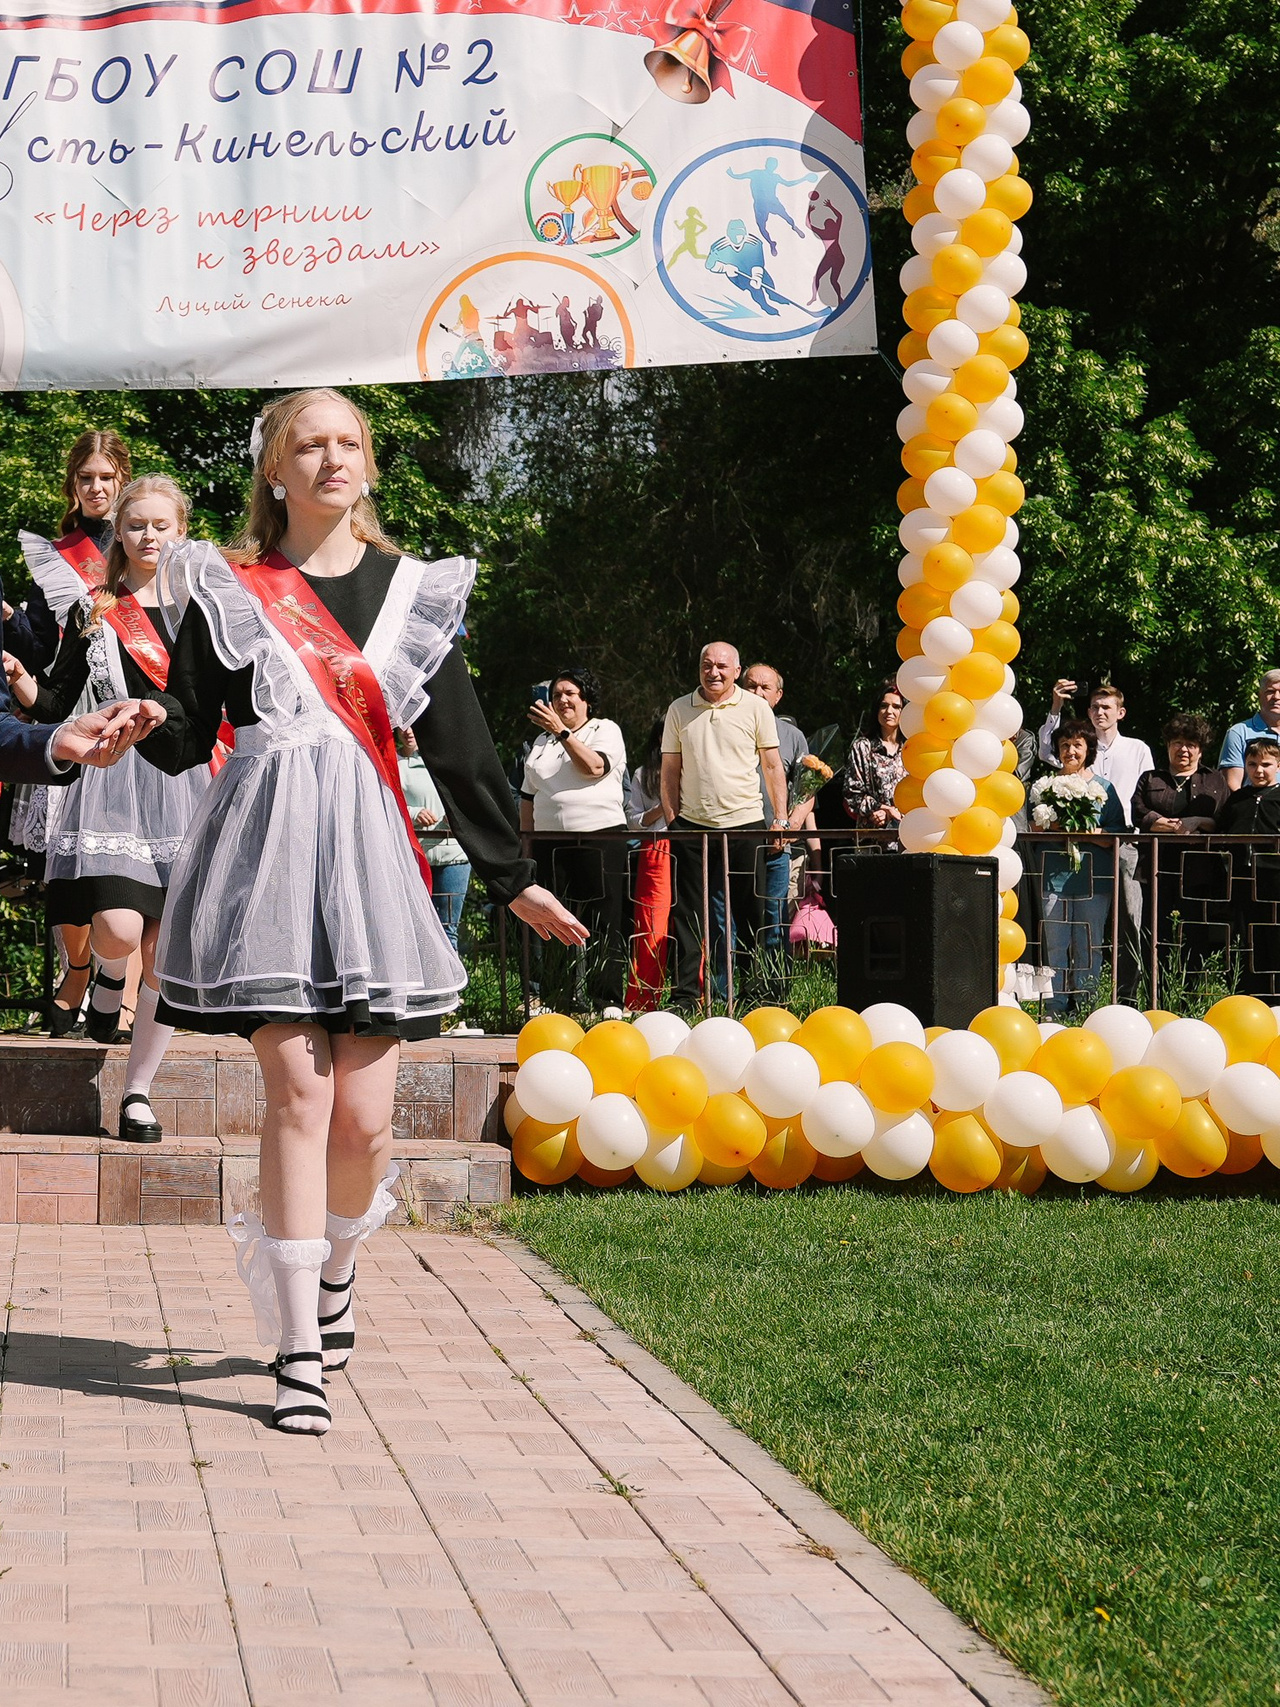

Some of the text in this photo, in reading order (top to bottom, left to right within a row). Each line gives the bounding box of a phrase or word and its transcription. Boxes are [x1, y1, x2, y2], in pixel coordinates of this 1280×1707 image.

[2, 53, 179, 104] ГБОУ
[209, 47, 363, 103] СОШ
[461, 38, 499, 87] 2
[33, 202, 374, 237] «Через тернии
[196, 236, 441, 275] к звездам»
[155, 291, 354, 318] Луций Сенека
